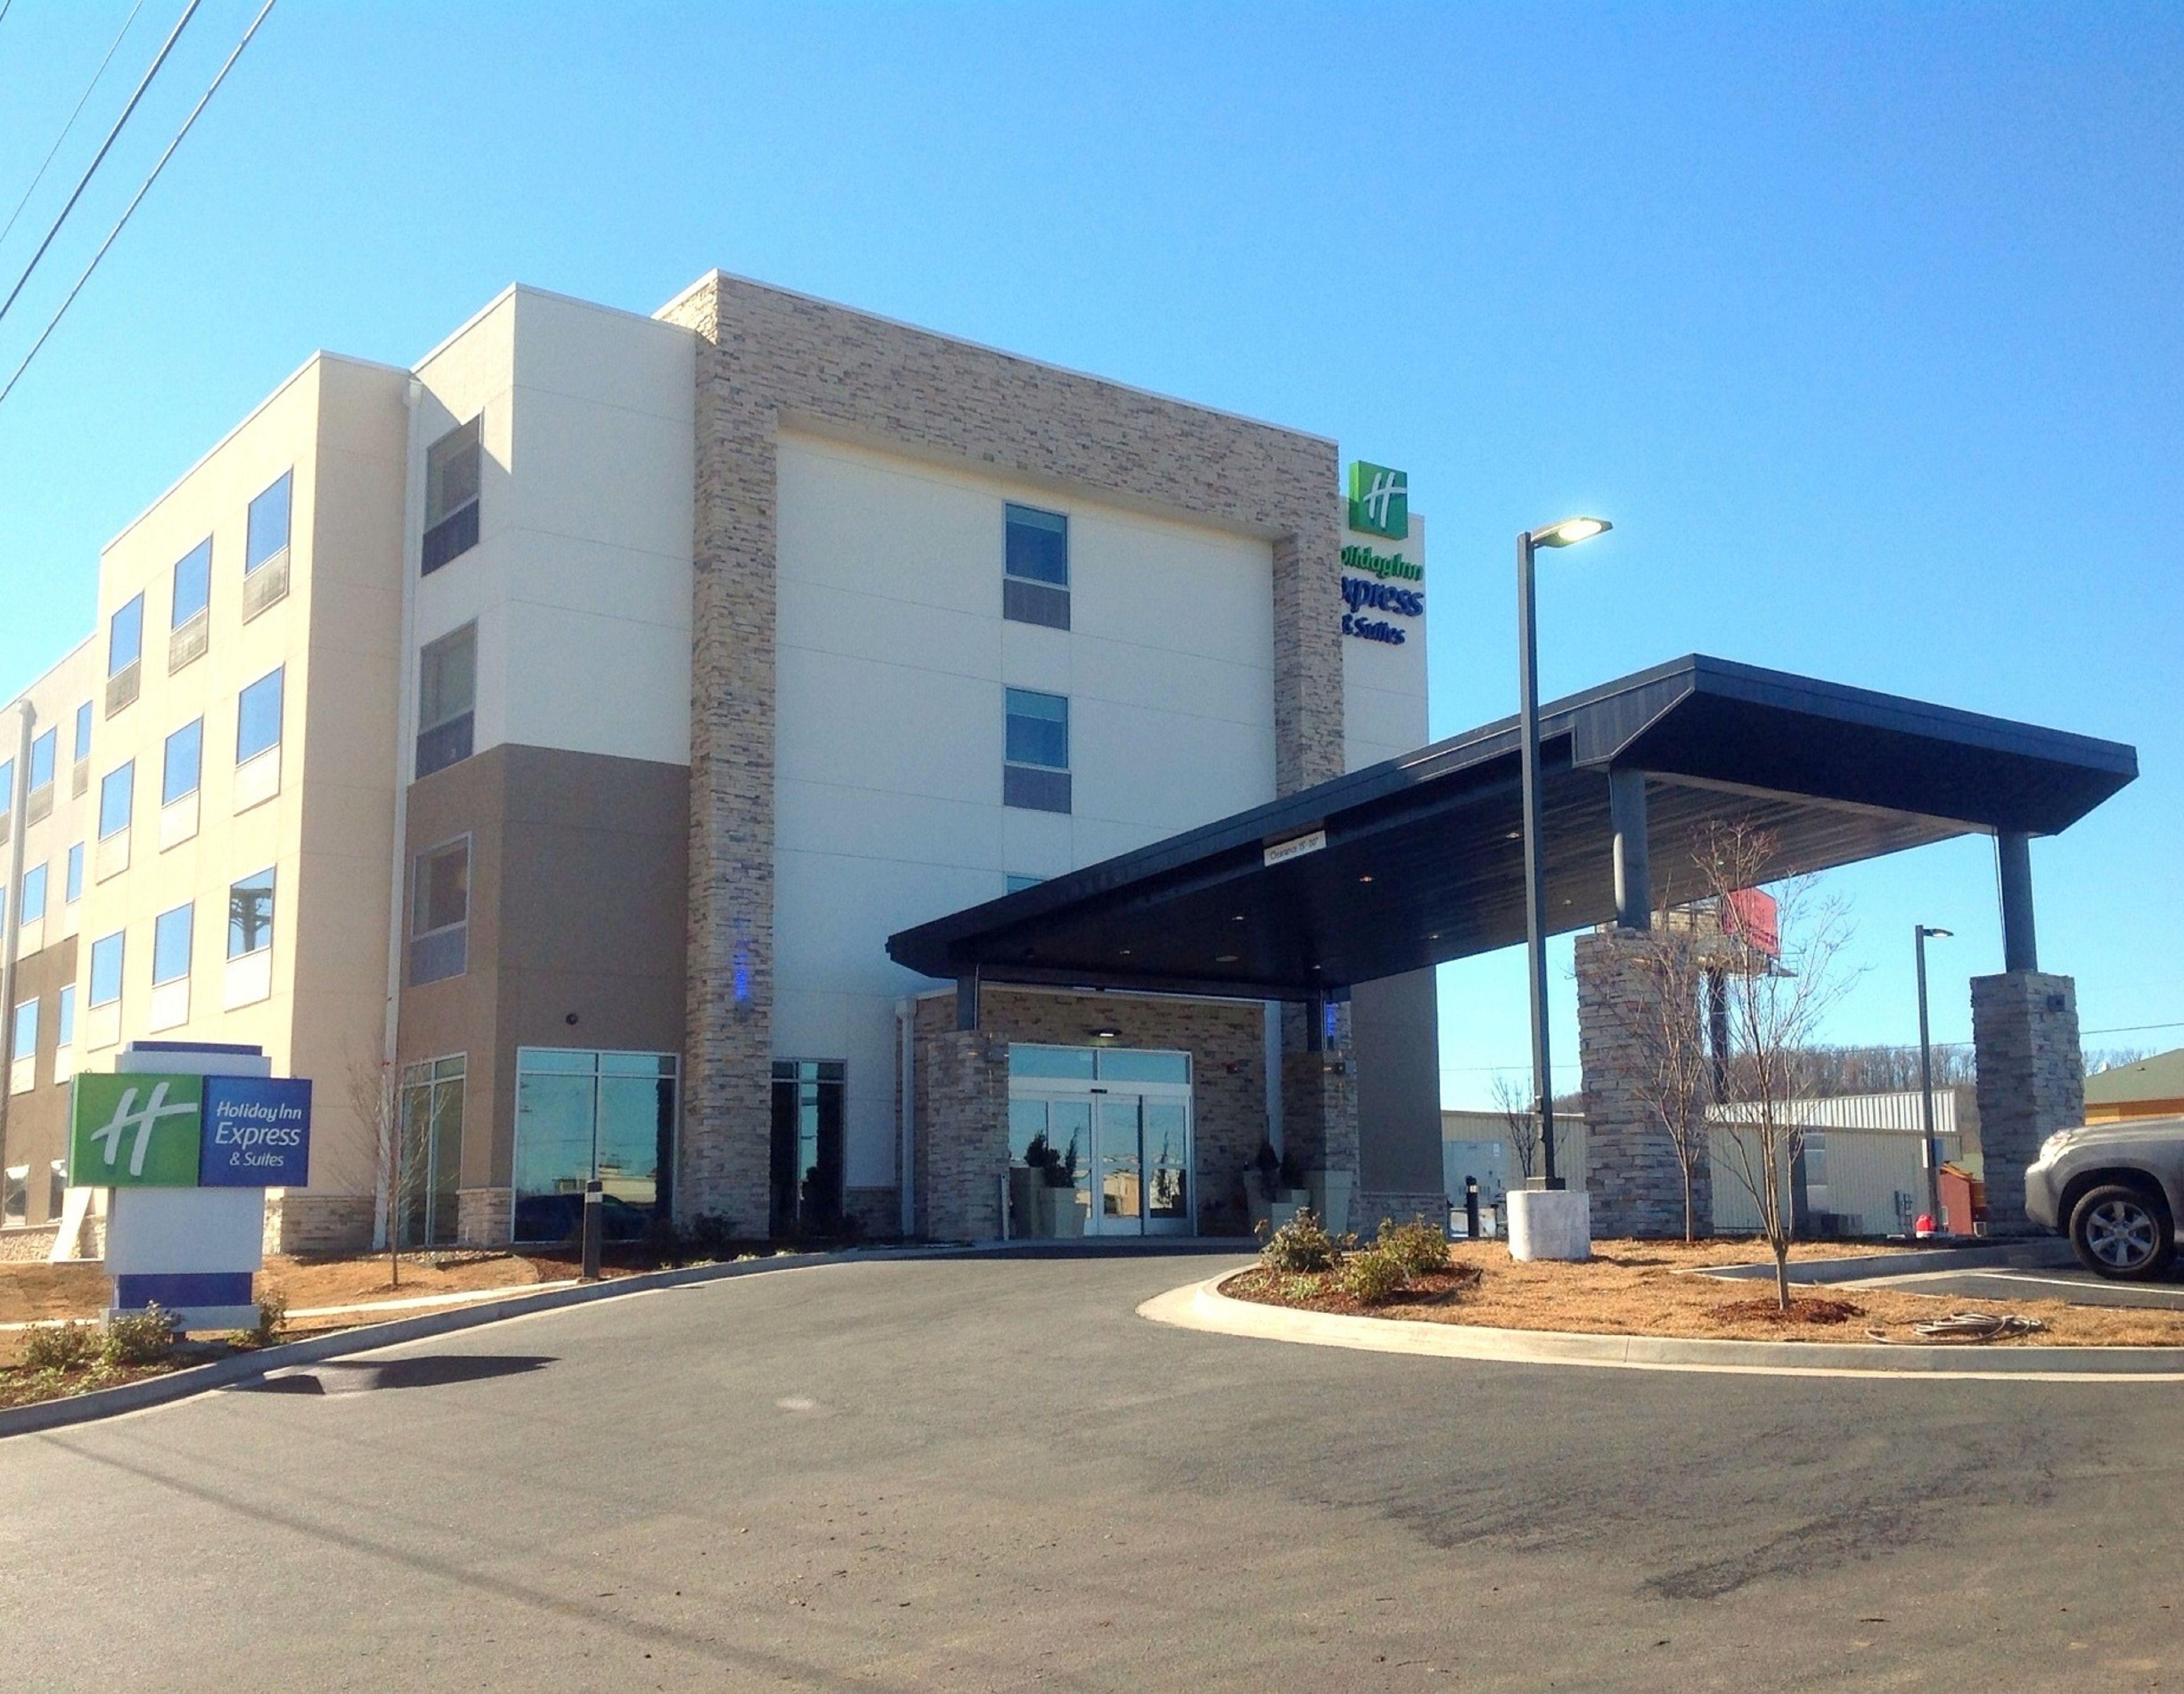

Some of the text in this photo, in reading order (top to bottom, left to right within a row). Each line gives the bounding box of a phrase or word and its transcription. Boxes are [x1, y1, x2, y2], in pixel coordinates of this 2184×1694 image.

[1341, 545, 1393, 579] oliday
[1341, 576, 1424, 617] xpress
[1354, 617, 1405, 645] Suites
[217, 1101, 302, 1123] Holiday Inn
[215, 1121, 301, 1150] Express
[229, 1152, 284, 1166] & Suites
